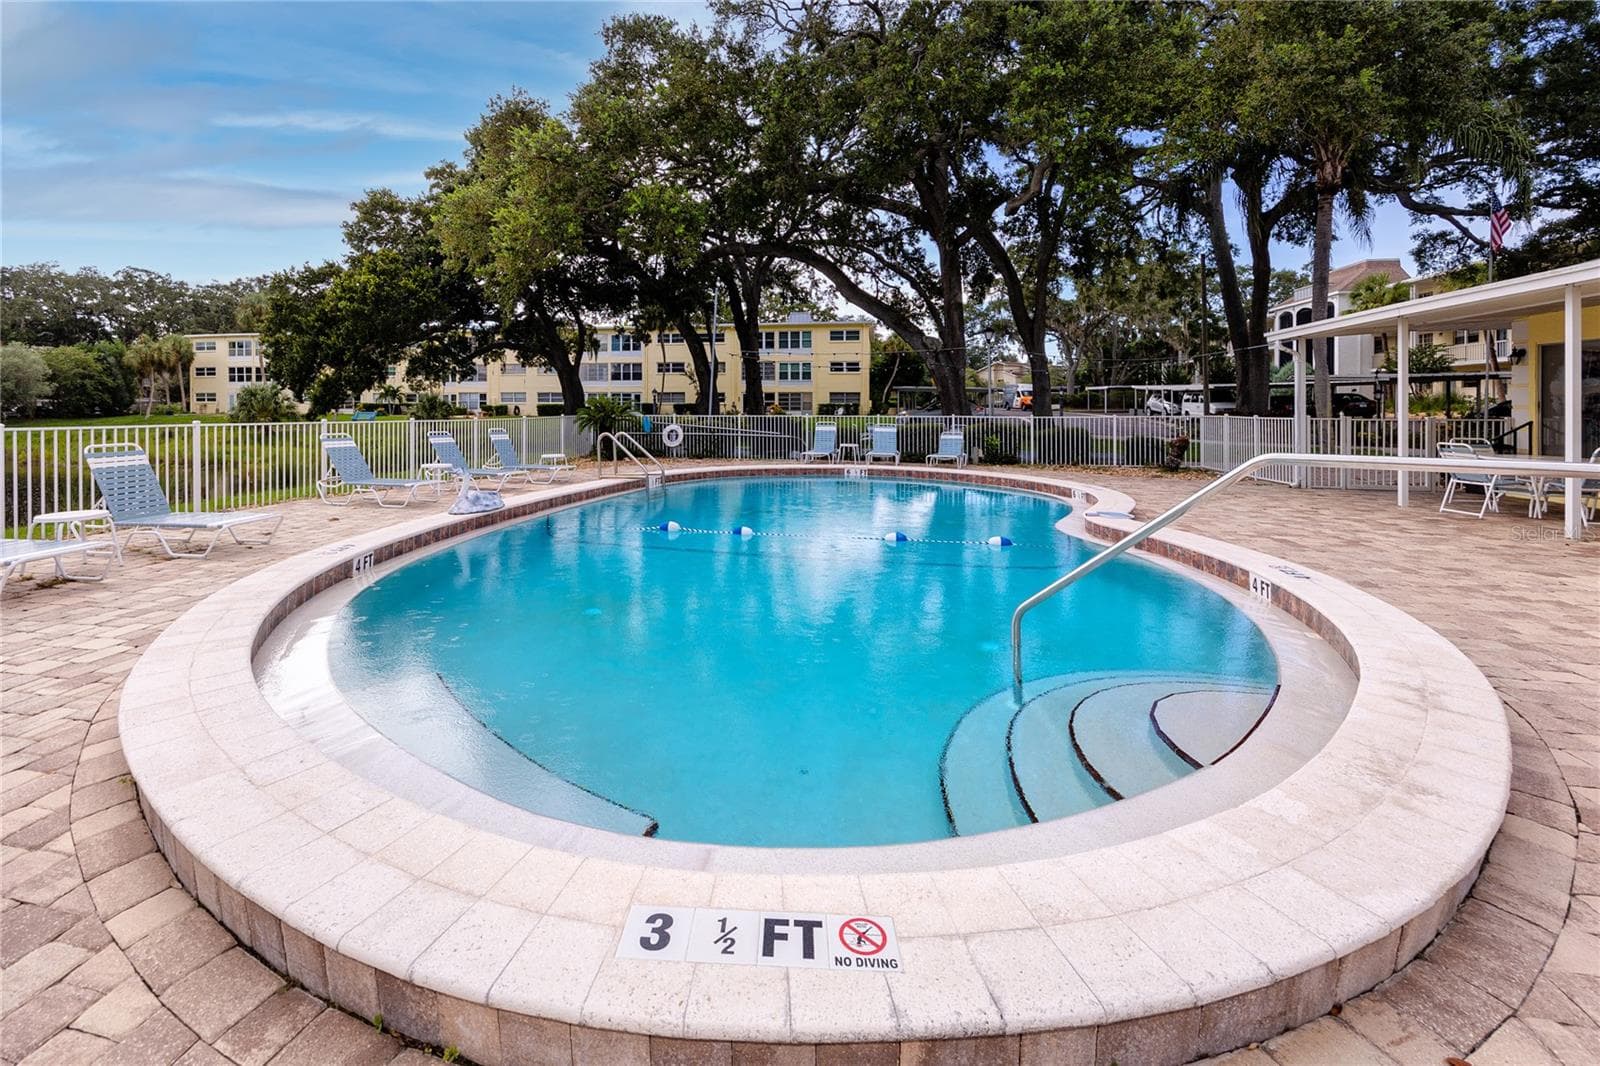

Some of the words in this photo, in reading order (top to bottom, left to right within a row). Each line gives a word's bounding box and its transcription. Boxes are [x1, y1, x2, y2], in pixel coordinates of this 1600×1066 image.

[355, 559, 361, 573] 4
[363, 553, 374, 570] FT
[1252, 577, 1258, 593] 4
[1260, 580, 1270, 600] FT
[639, 913, 674, 951] 3
[761, 917, 823, 960] FT
[834, 956, 851, 967] NO
[856, 957, 898, 969] DIVING
